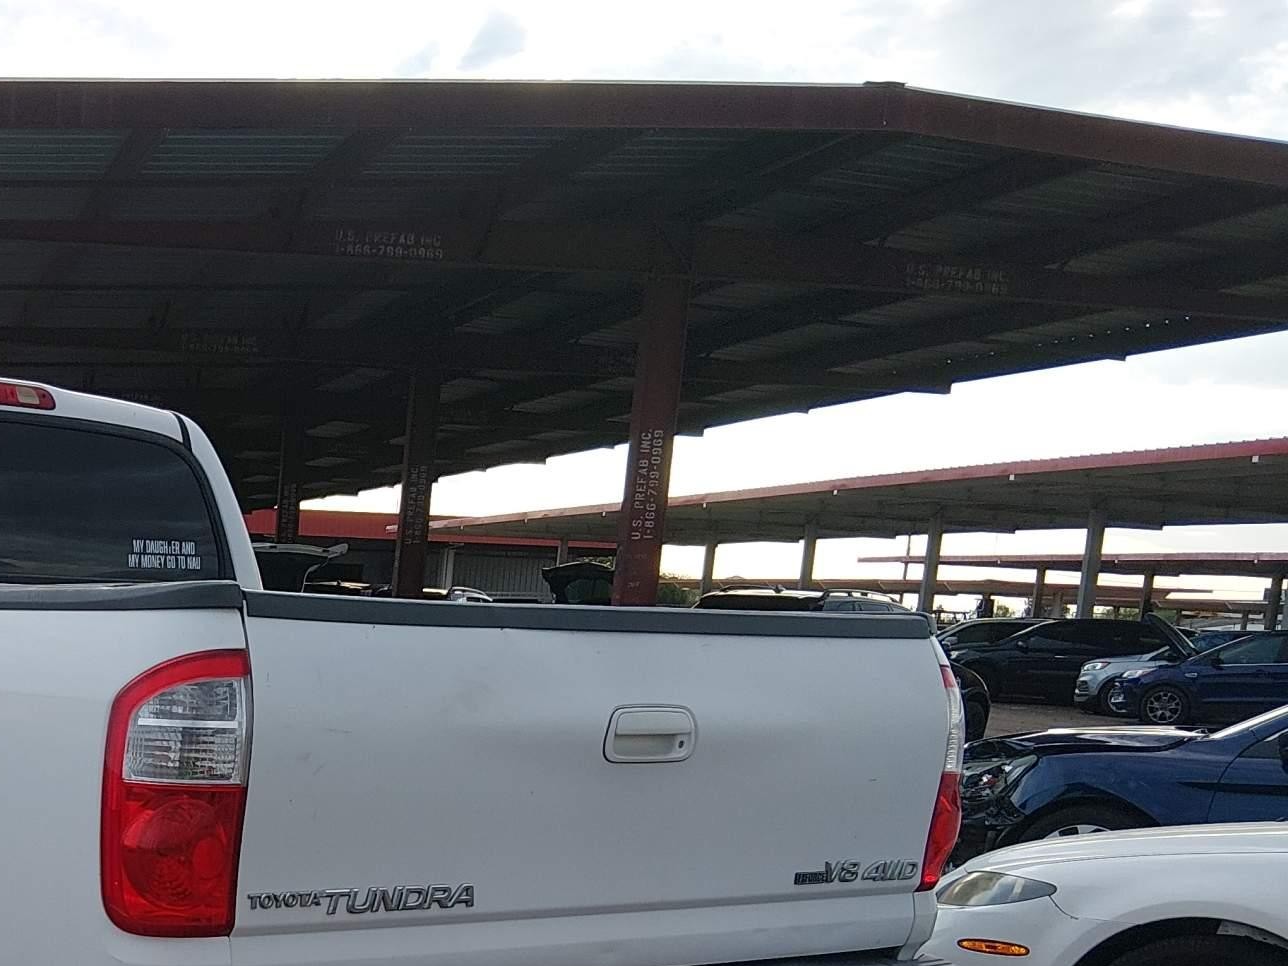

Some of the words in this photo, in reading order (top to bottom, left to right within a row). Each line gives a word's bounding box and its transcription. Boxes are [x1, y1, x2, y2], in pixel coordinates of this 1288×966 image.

[640, 429, 653, 453] INC.
[634, 460, 649, 509] PREFAB
[643, 430, 664, 539] 1-866-799-0969
[631, 516, 643, 540] U.S.
[132, 539, 145, 553] MY
[181, 541, 196, 555] AND
[128, 554, 139, 568] MY
[140, 554, 165, 569] MONEY
[166, 555, 176, 569] GO
[177, 556, 186, 569] TO
[825, 860, 861, 882] V8
[861, 859, 919, 882] 4WD
[248, 890, 321, 909] TOYOTA
[322, 883, 475, 915] TUNDRA
